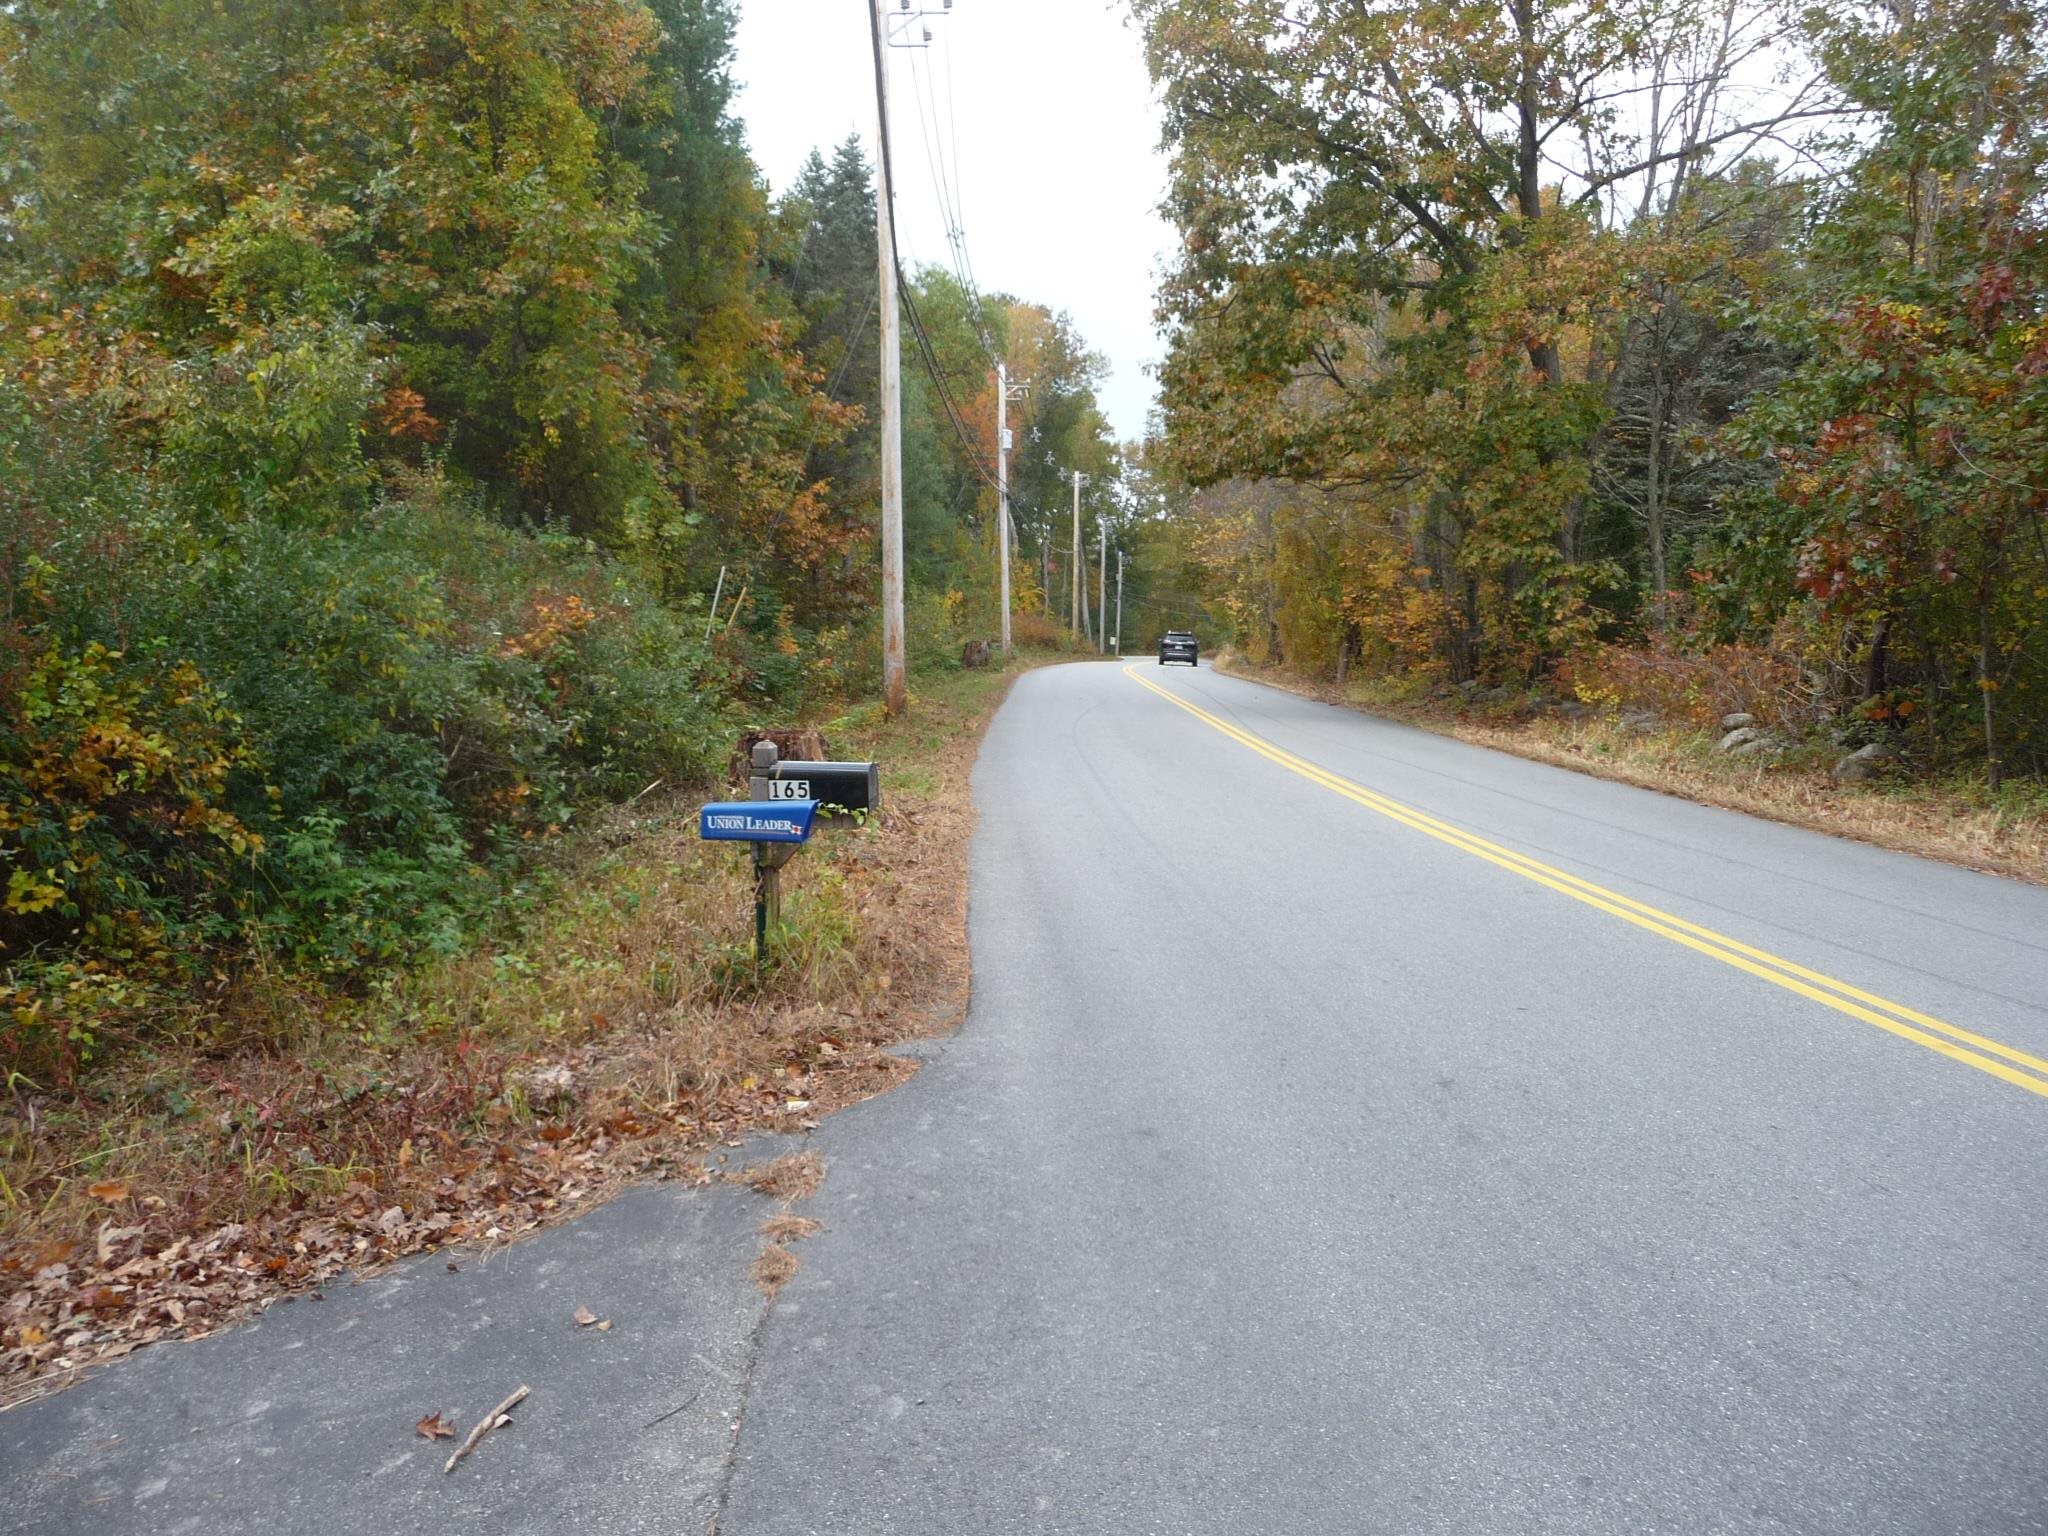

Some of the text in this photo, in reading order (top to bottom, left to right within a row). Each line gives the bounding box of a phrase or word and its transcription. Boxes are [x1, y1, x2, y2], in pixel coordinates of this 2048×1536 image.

[772, 782, 808, 798] 165
[707, 816, 792, 830] UNION LEADER
